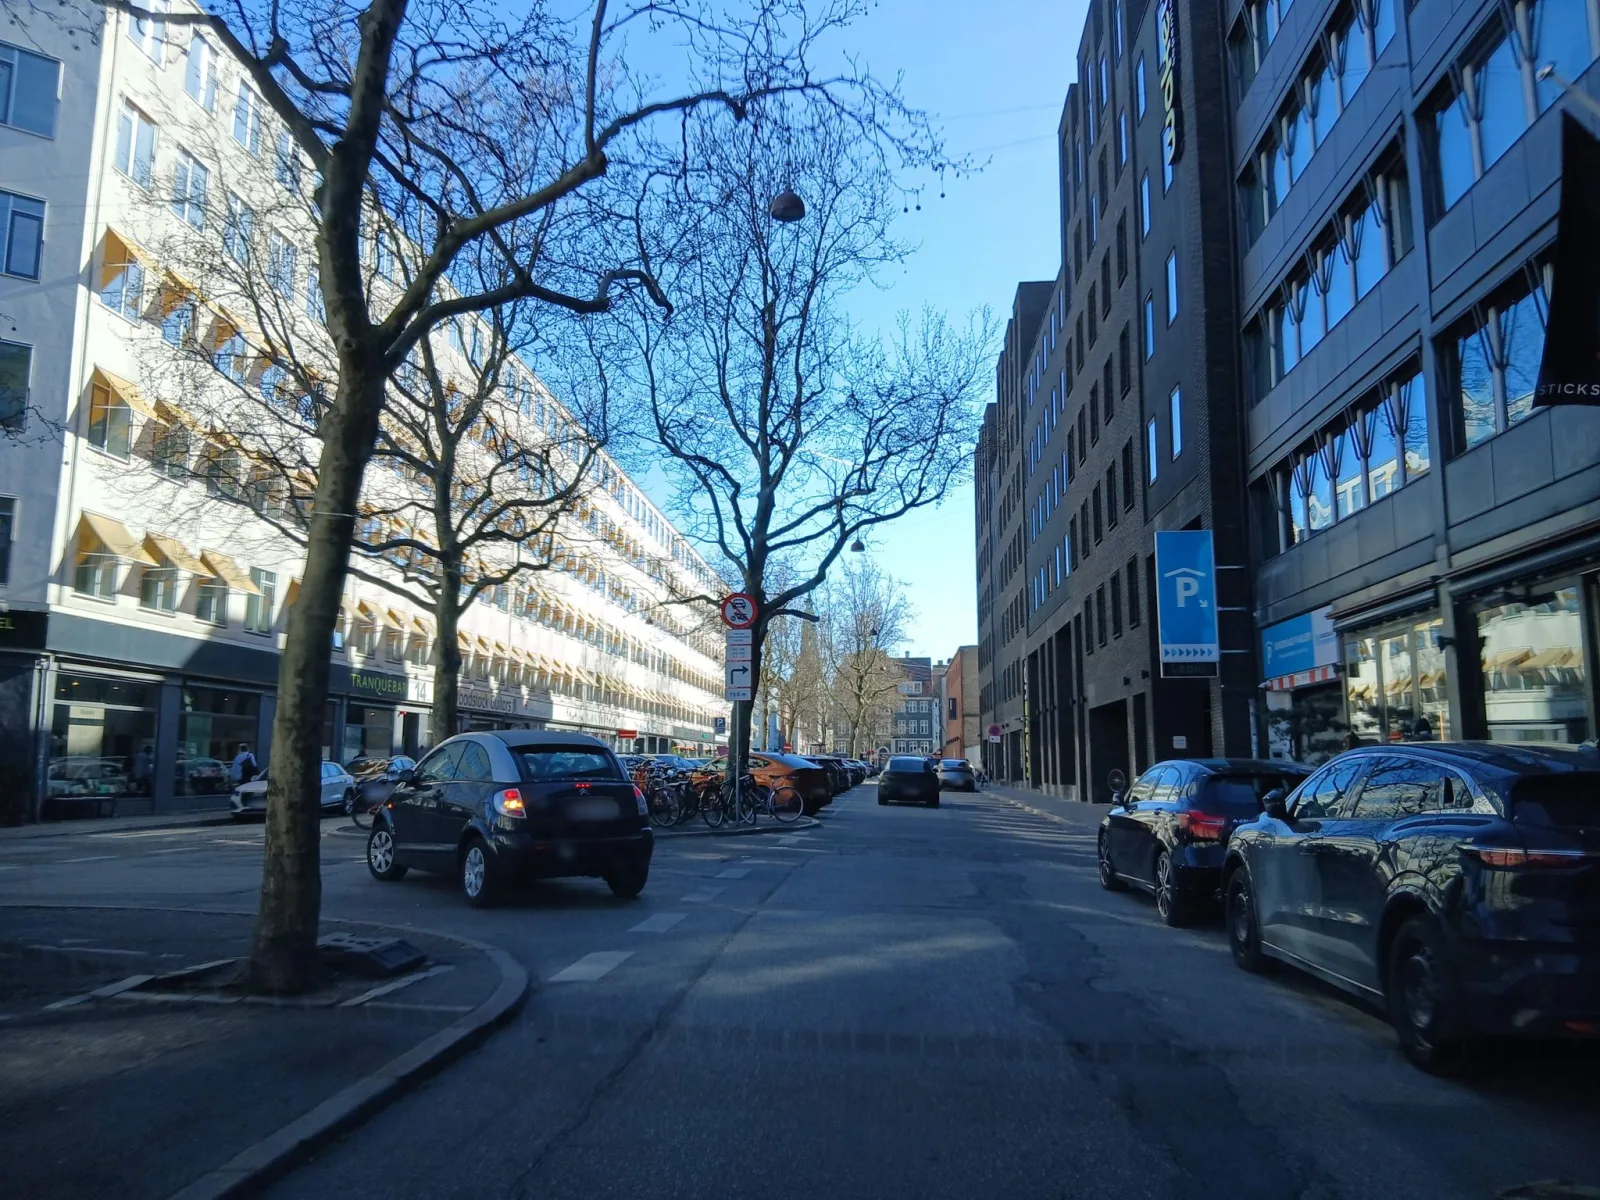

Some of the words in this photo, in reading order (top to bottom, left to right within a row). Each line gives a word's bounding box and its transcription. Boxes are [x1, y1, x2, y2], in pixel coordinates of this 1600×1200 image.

[1176, 577, 1199, 608] P
[415, 682, 427, 702] 14
[458, 692, 489, 709] oodstock
[716, 718, 724, 727] P
